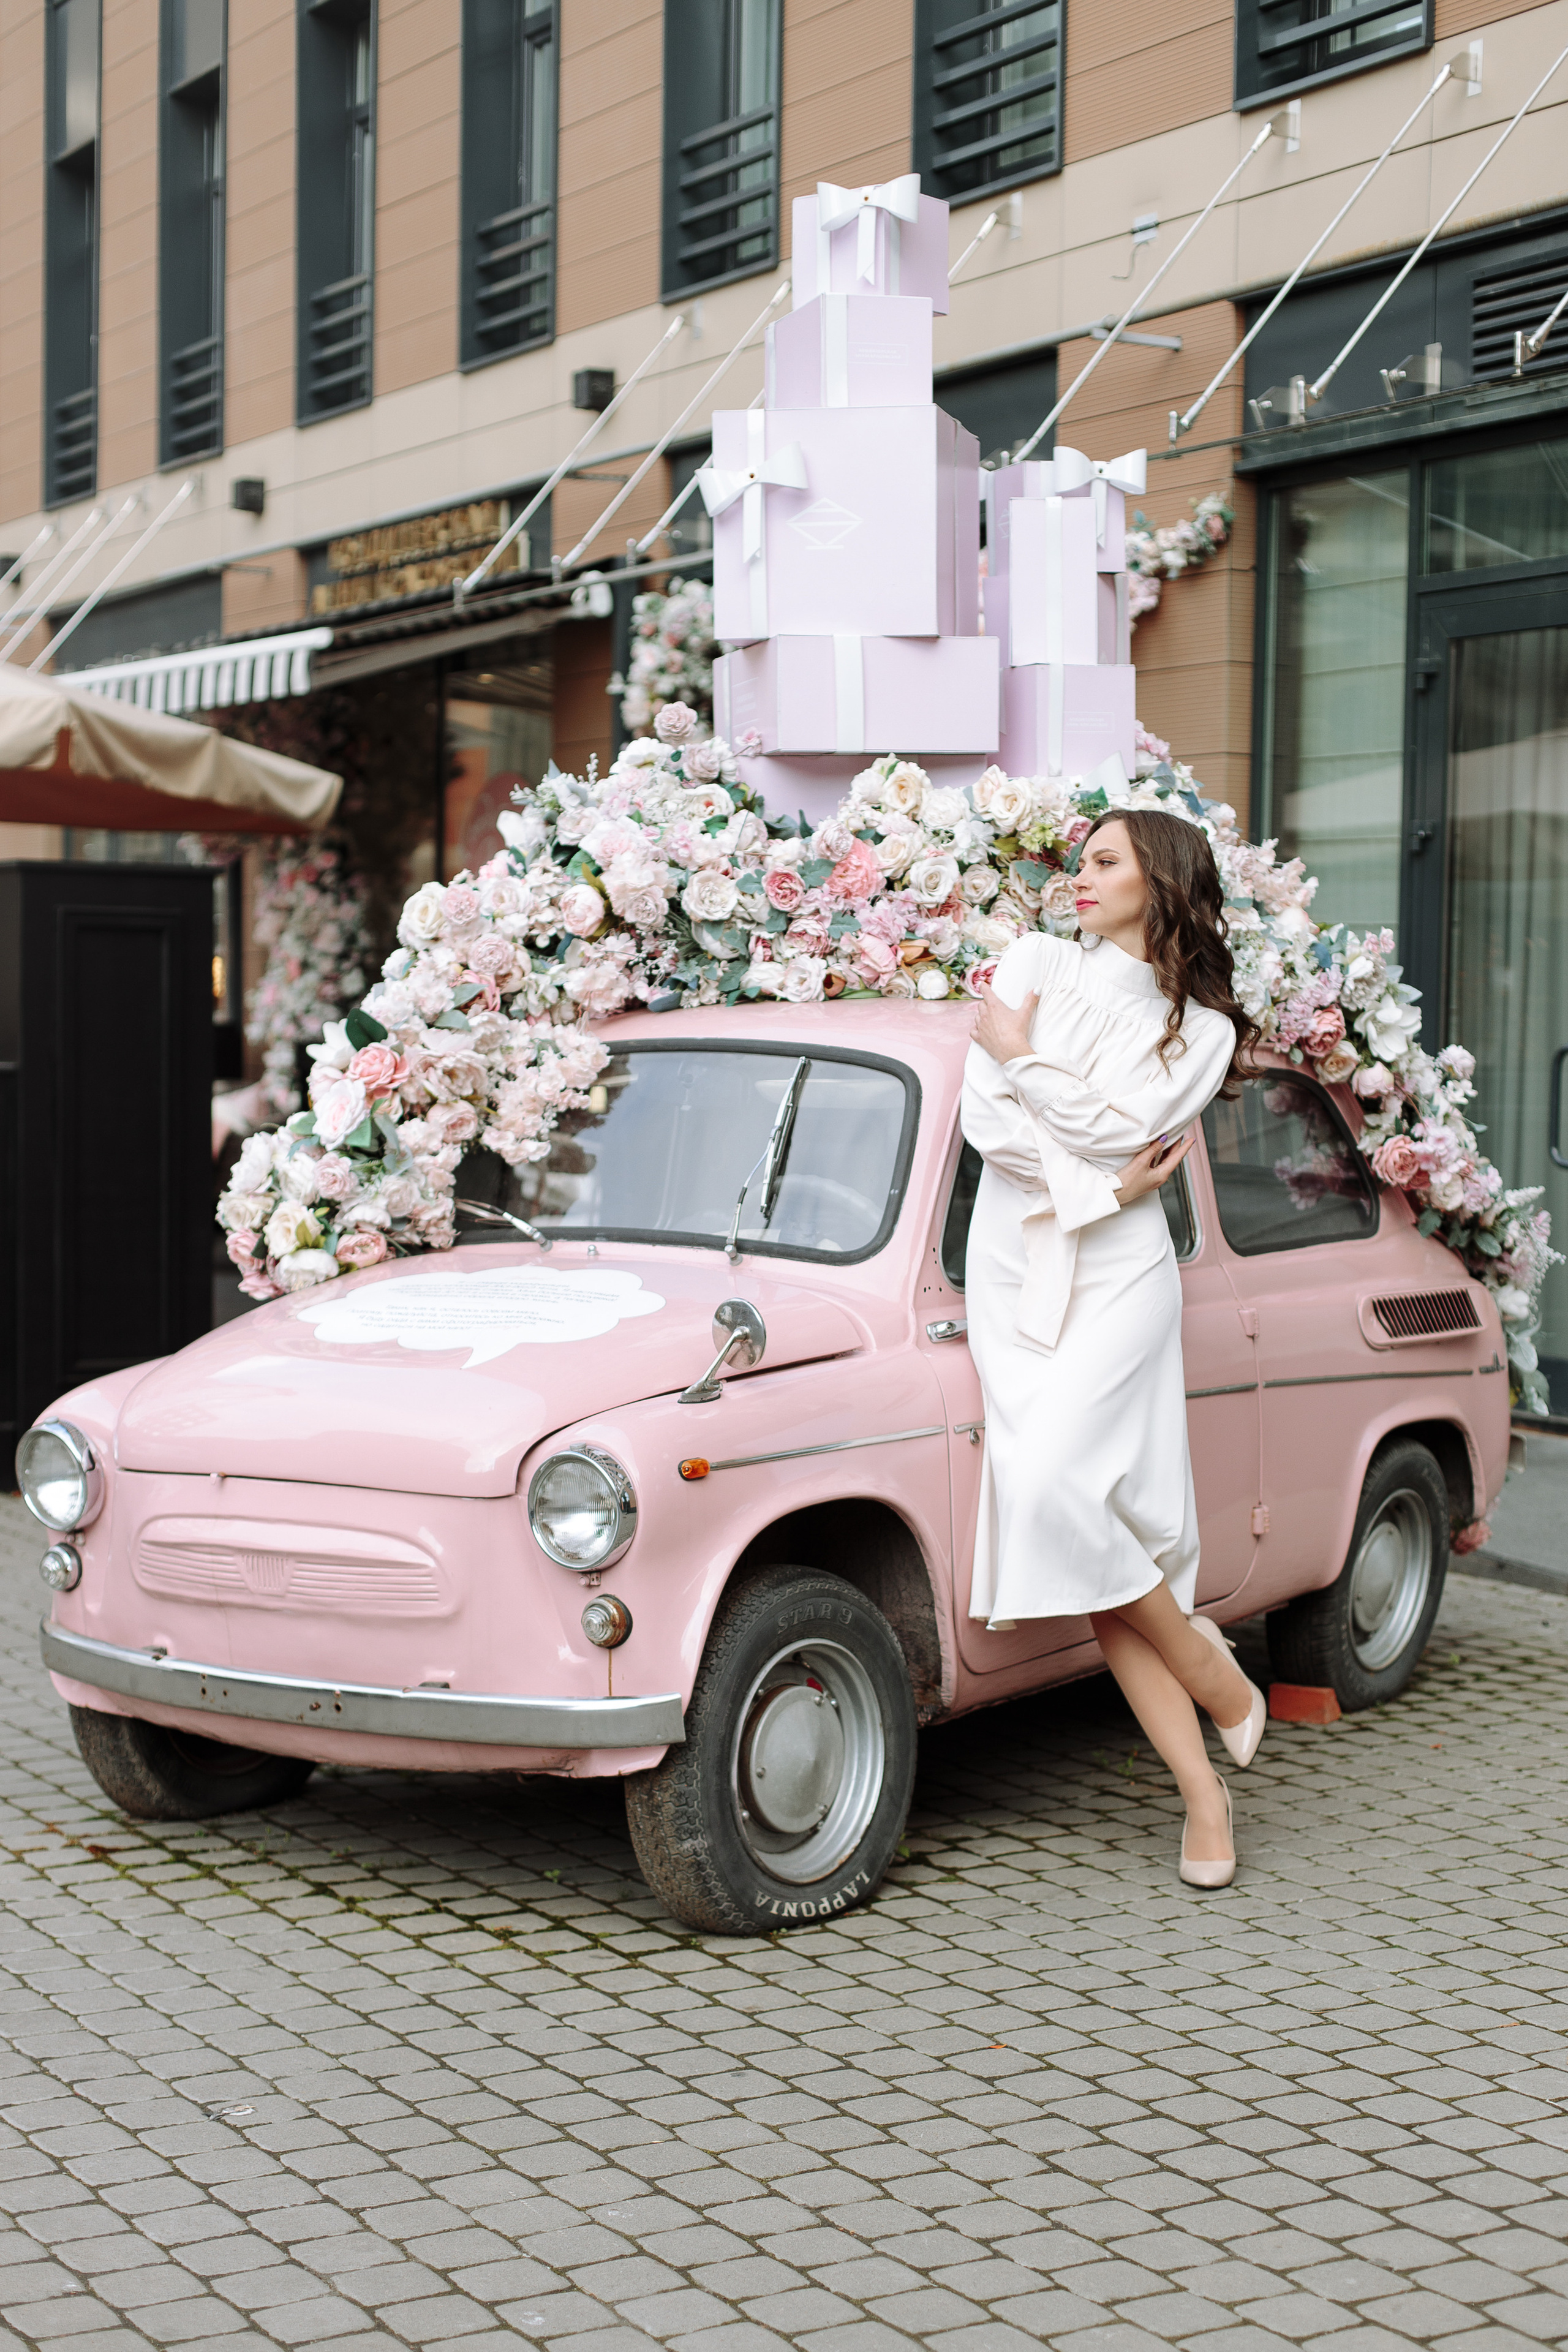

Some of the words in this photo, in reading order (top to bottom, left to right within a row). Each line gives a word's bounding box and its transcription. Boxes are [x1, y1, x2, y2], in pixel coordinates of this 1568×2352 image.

[776, 1602, 834, 1634] STAR
[838, 1605, 853, 1624] 9
[755, 1868, 872, 1918] LAPPONIA
